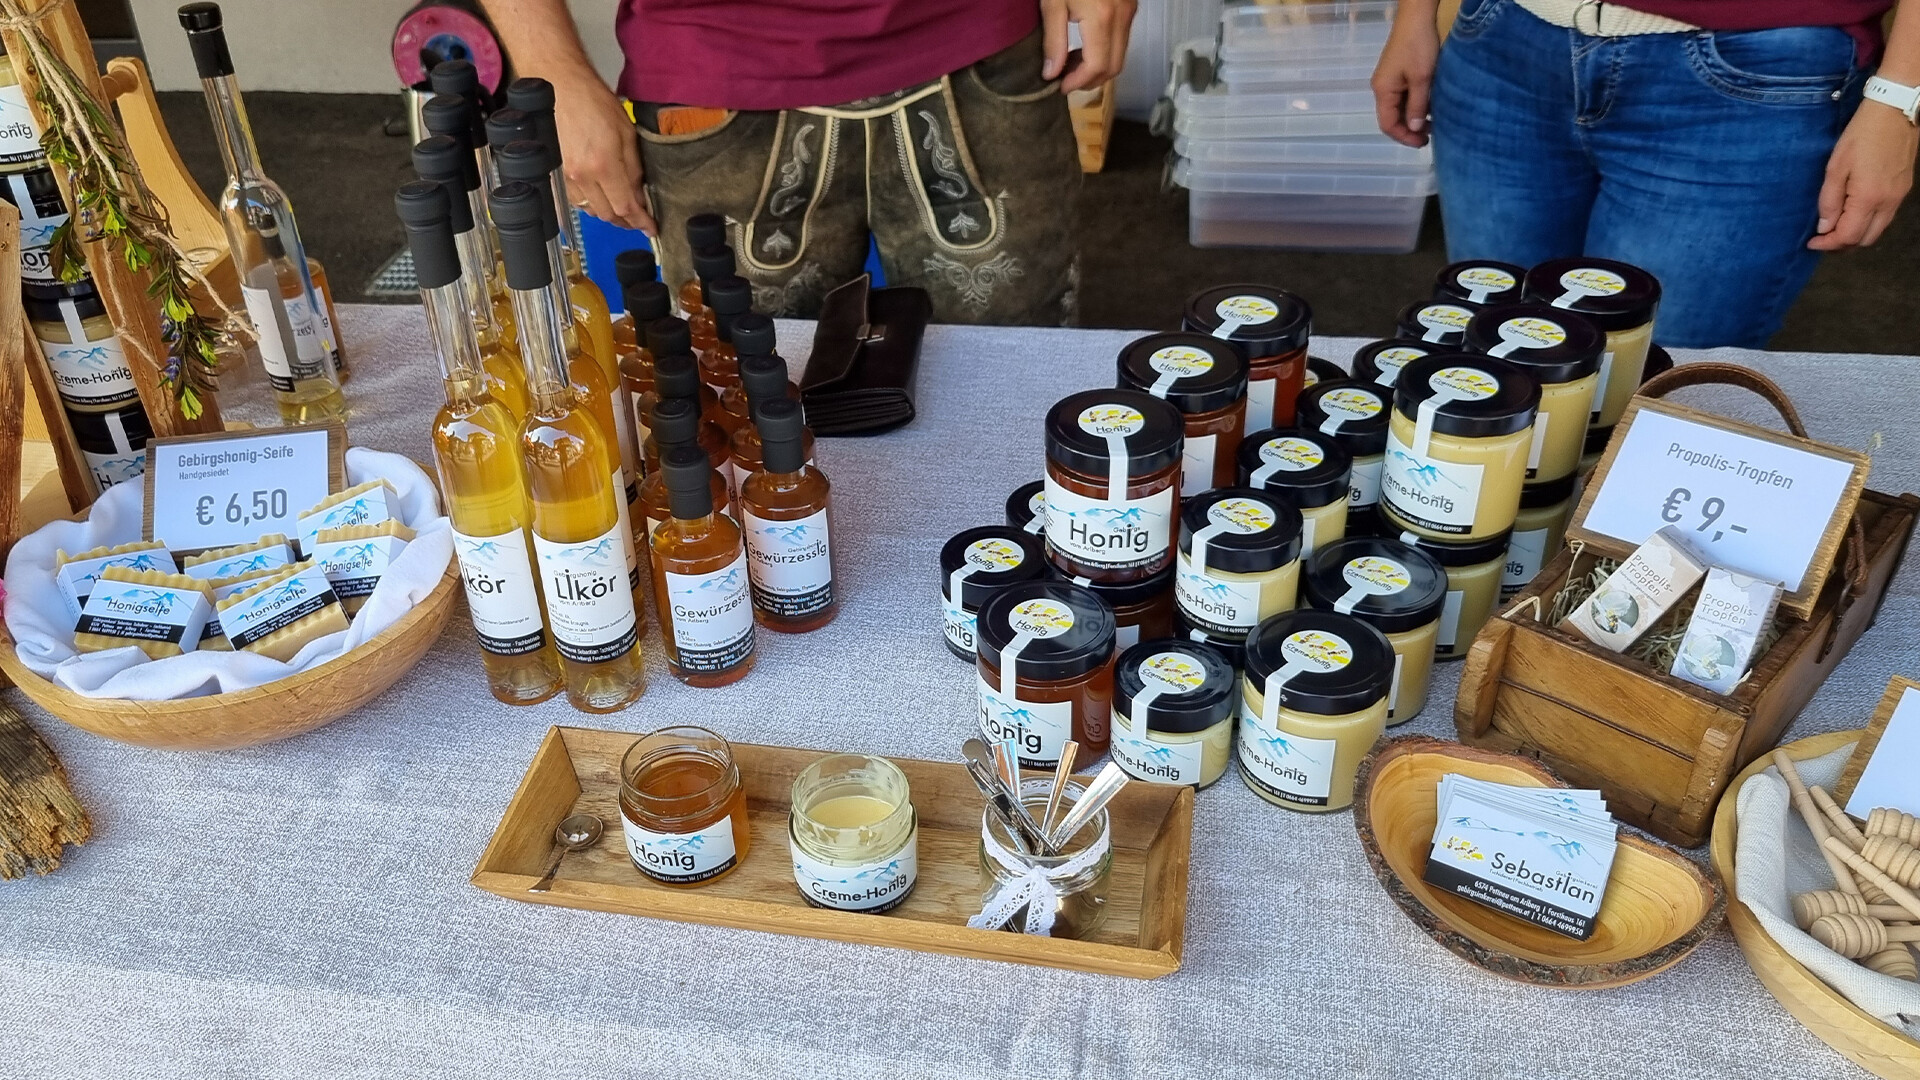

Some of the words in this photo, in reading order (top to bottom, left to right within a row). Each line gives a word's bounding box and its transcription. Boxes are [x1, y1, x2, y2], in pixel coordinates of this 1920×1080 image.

[1223, 309, 1253, 322] Honig
[1158, 362, 1191, 375] Honig
[1433, 377, 1479, 397] Creme-Honig
[1096, 424, 1131, 434] Honig
[178, 445, 294, 468] Gebirgshonig-Seife
[1666, 442, 1794, 491] Propolis-Tropfen
[179, 468, 229, 480] Handgesiedet
[1383, 463, 1454, 513] Creme-Honig
[196, 495, 215, 526] €
[225, 488, 288, 527] 6,50
[1661, 487, 1691, 522] €
[1070, 518, 1149, 553] Honig
[1083, 545, 1106, 555] Arlberg
[749, 539, 827, 563] Gewürzessig
[969, 552, 994, 570] Honig
[459, 553, 506, 594] ikör
[555, 569, 617, 601] Likör
[1346, 567, 1393, 591] Creme-Honig
[1626, 562, 1661, 596] Tropfen
[1633, 554, 1674, 593] Propolis-
[106, 598, 171, 616] Honigseife
[244, 588, 307, 621] Honigseife
[1176, 581, 1237, 621] eme-Honig
[1702, 602, 1746, 626] Tropfen
[1704, 593, 1758, 617] Propolis-
[1016, 618, 1048, 636] Honig
[1286, 642, 1332, 669] Creme-Honig
[1142, 668, 1187, 692] Creme-Honig
[980, 706, 1042, 754] Honig
[633, 839, 696, 871] Honig
[811, 873, 907, 902] Creme-Honig
[1490, 852, 1595, 904] Sebastian
[1456, 884, 1530, 917] gebirgsimkerei@pettneu.at
[1541, 914, 1556, 926] 0664
[1557, 921, 1584, 936] 4699950
[1474, 880, 1489, 891] 6574
[1489, 885, 1510, 899] Pettneu
[1510, 894, 1520, 903] am
[1520, 897, 1541, 912] Arlberg
[1547, 907, 1575, 923] Forsthaus
[1576, 917, 1586, 927] 161
